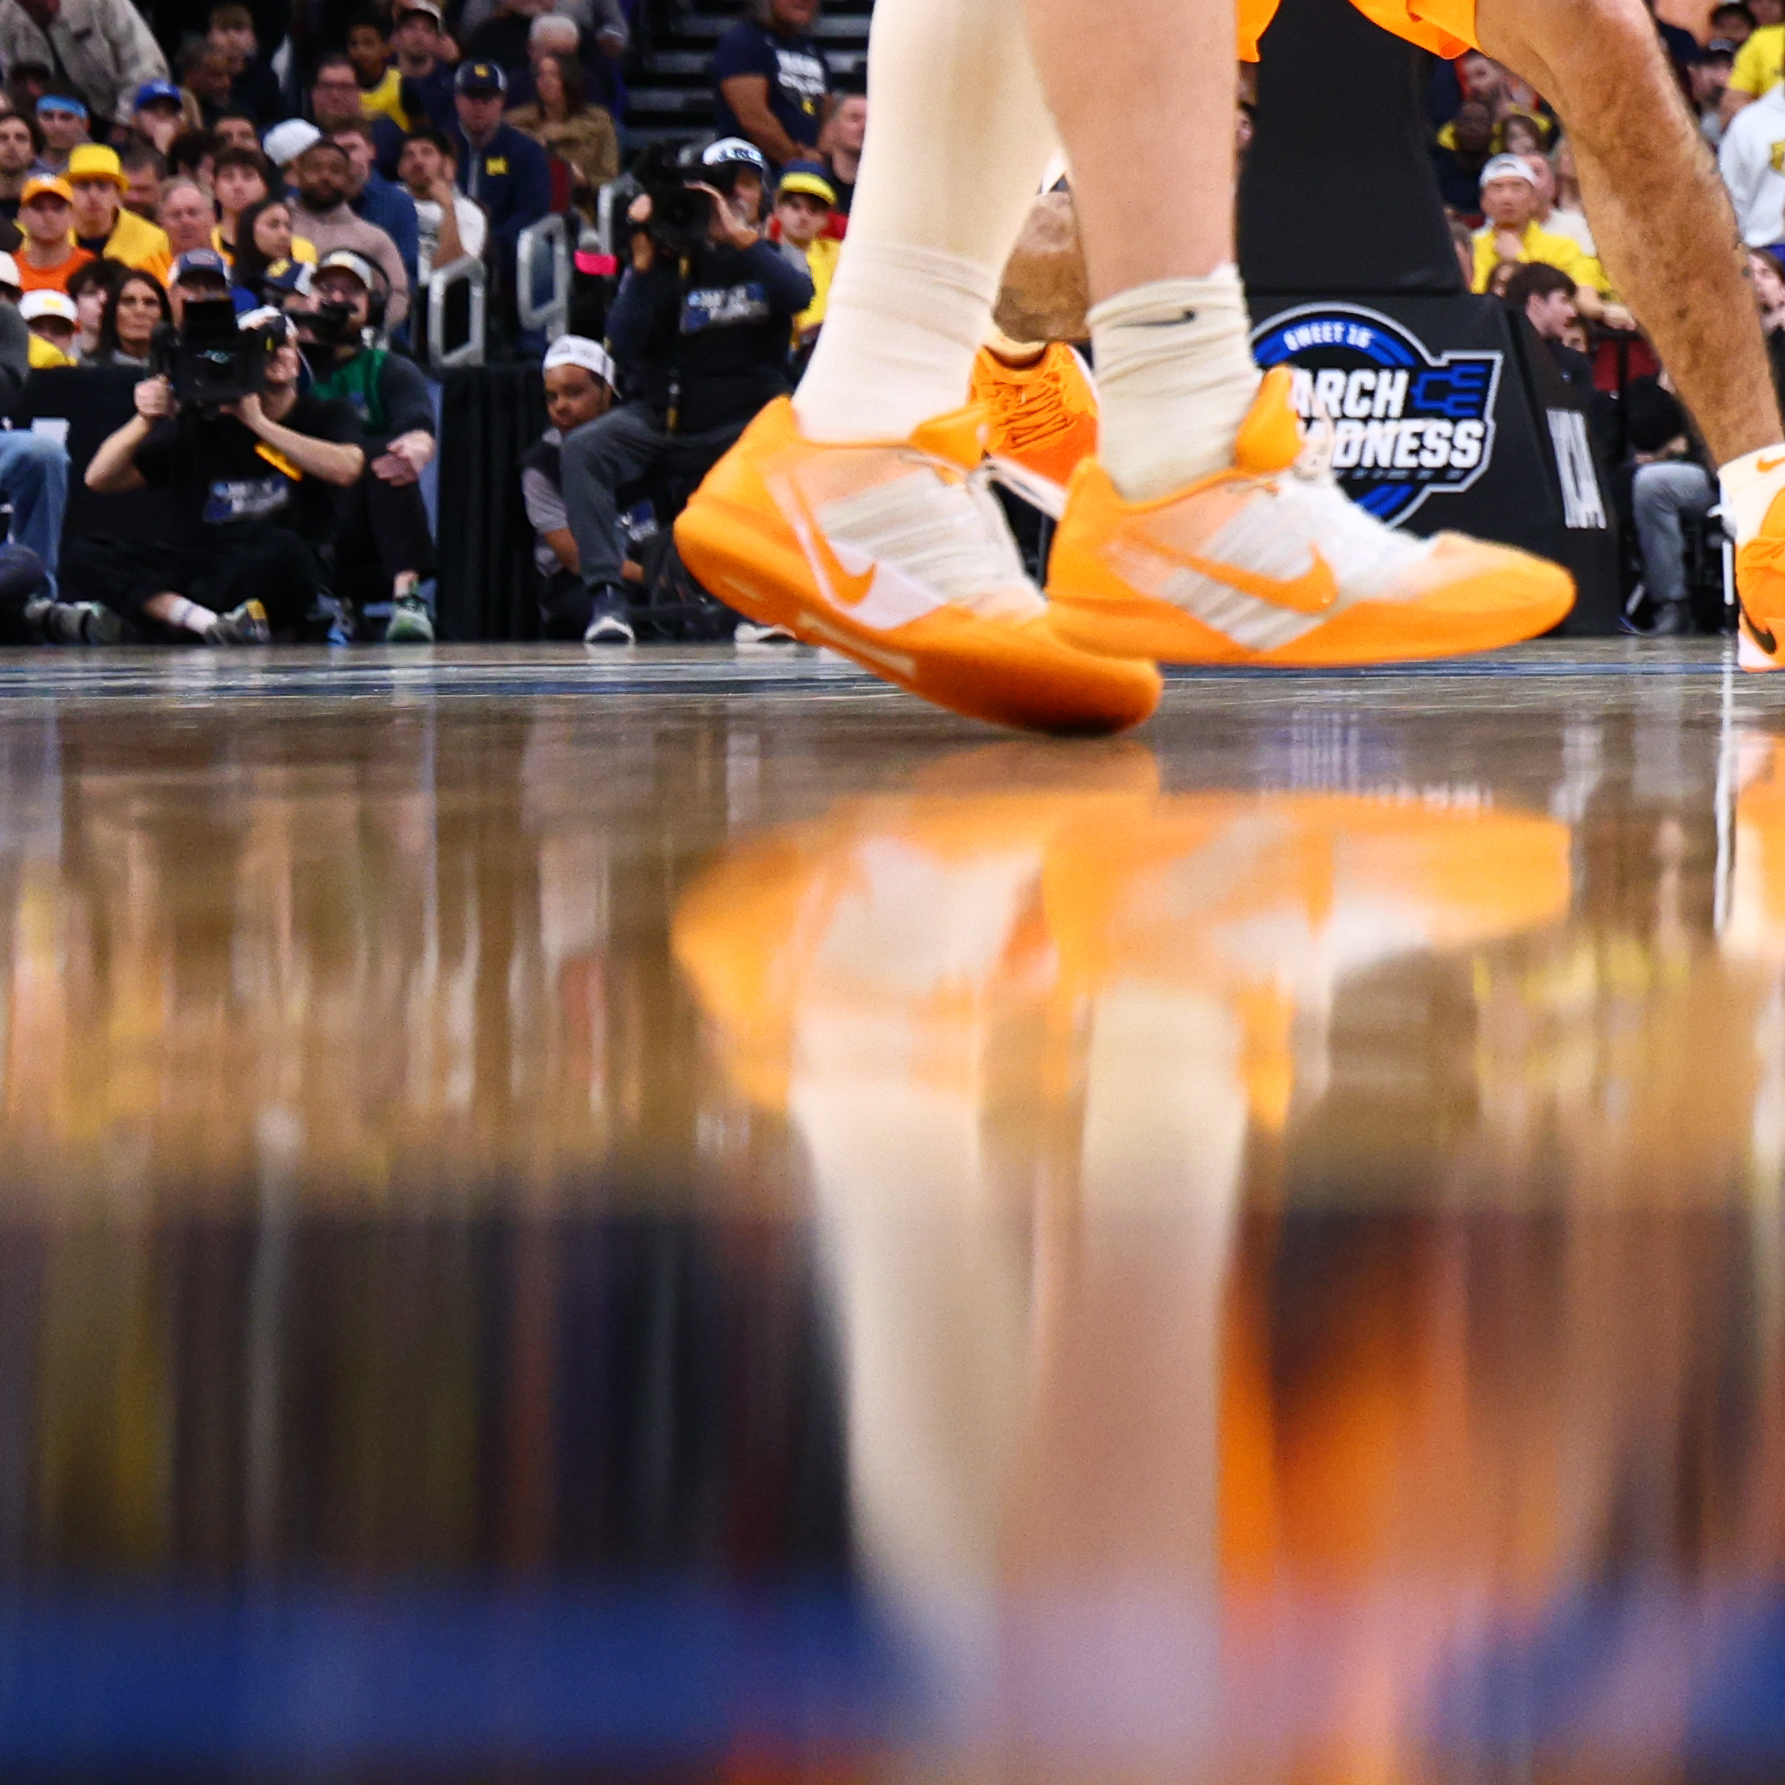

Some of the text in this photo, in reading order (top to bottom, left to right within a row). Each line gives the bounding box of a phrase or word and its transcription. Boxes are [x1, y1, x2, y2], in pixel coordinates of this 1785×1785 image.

[1283, 322, 1374, 351] SWEET 16
[1290, 369, 1410, 417] ARCH
[1297, 418, 1485, 468] DNESS
